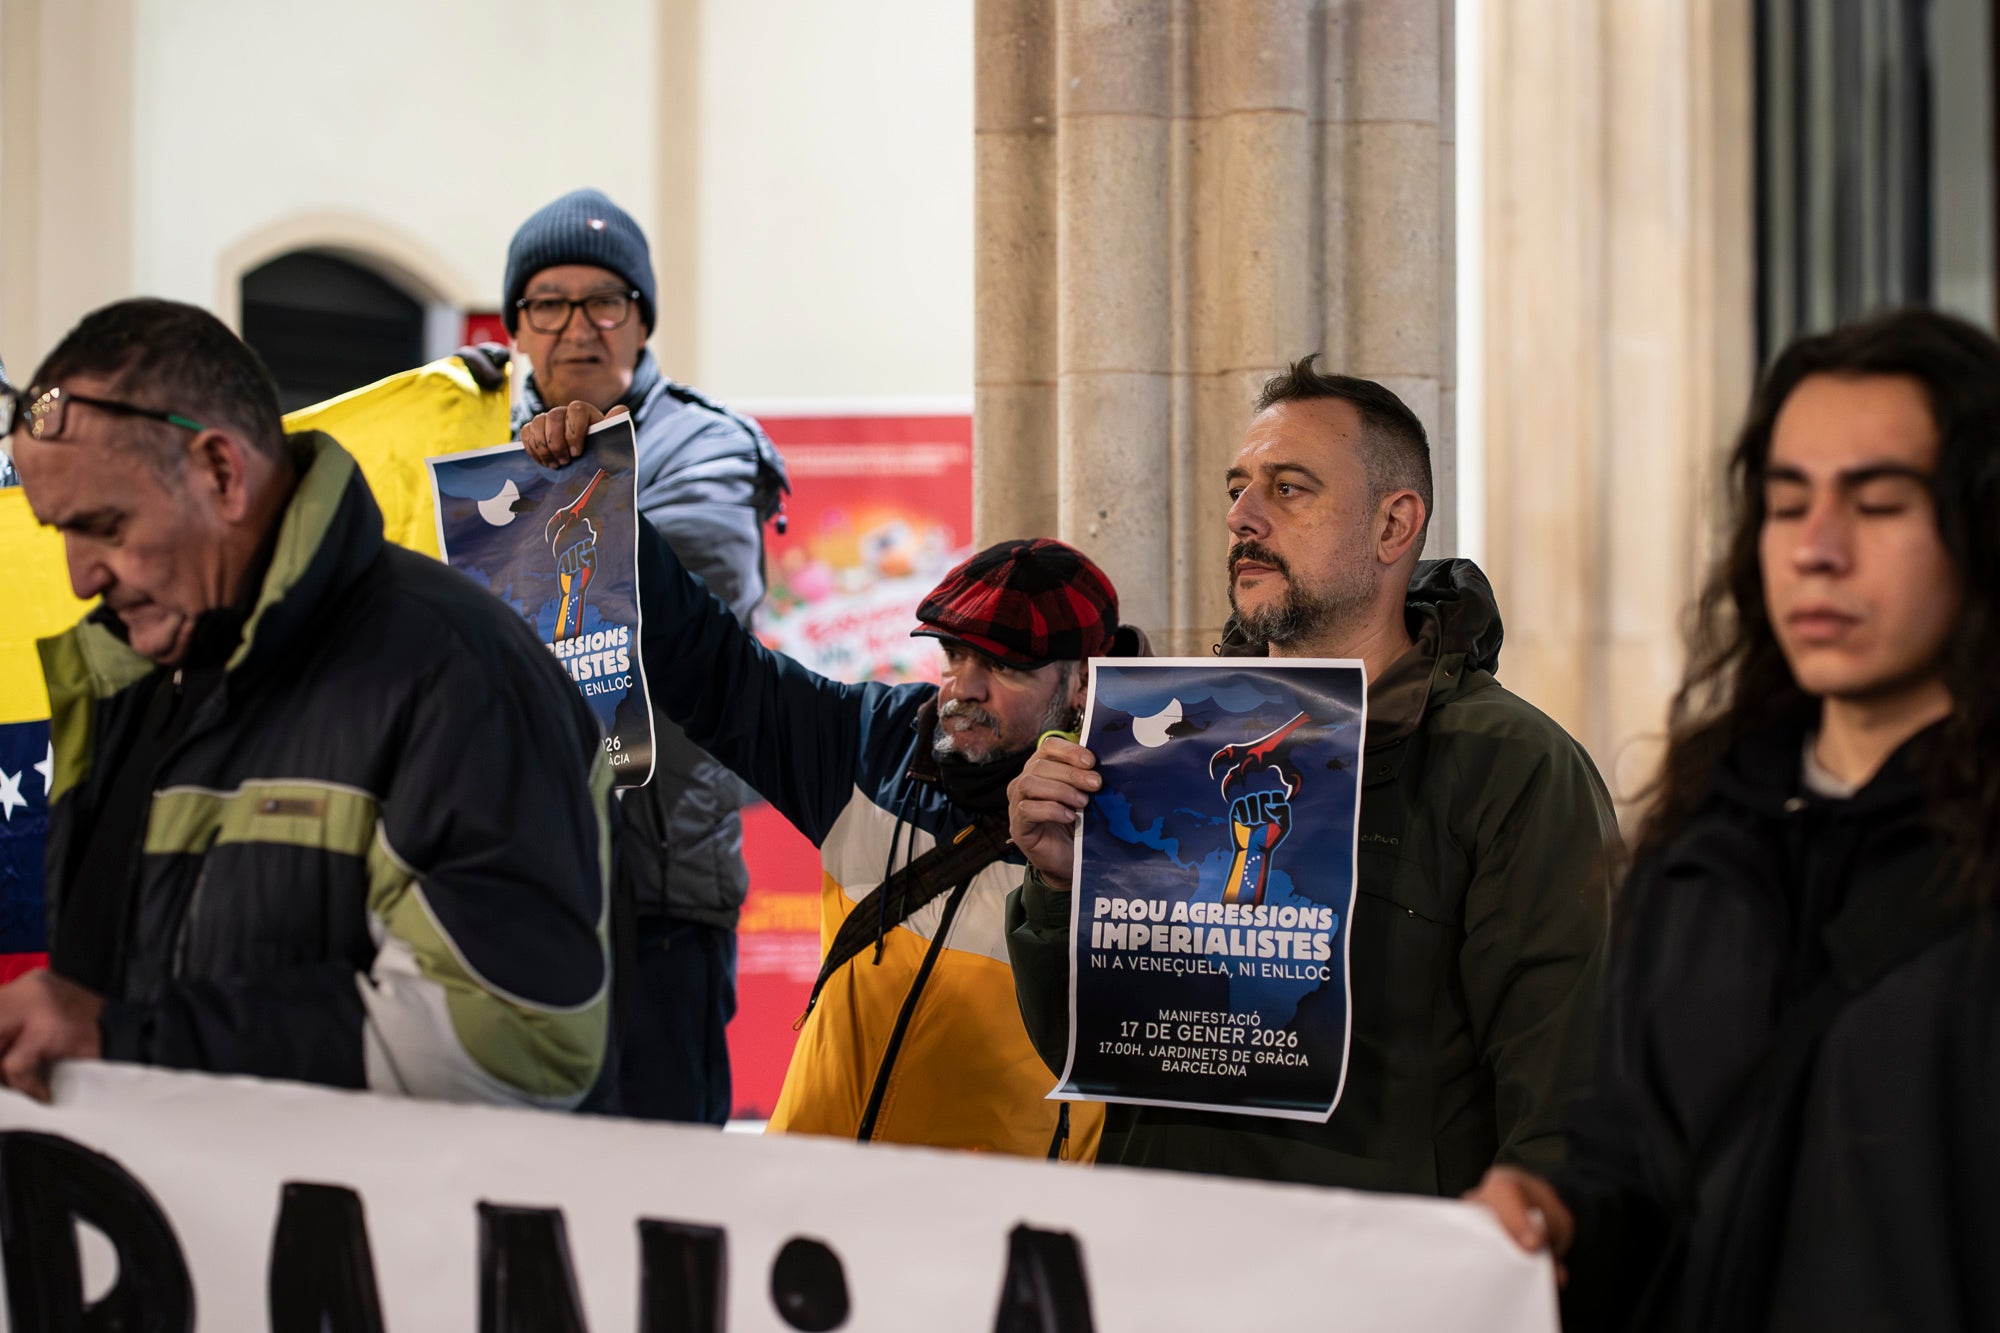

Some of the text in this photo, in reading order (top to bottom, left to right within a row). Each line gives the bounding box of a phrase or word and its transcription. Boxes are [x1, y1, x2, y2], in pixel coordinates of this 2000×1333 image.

[585, 675, 633, 697] ENLLOC
[602, 736, 621, 752] 26
[608, 753, 630, 766] ÀCIA
[1093, 897, 1333, 930] PROU AGRESSIONS
[1091, 922, 1331, 961] IMPERIALISTES
[1091, 954, 1331, 981] NI A VENEÇUELA, NI ENLLOC
[1158, 1009, 1261, 1027] MANIFESTACIÓ
[1120, 1021, 1298, 1048] 17 DE GENER 2026
[1099, 1041, 1309, 1067] 17.00H. JARDINETS DE GRÀCIA
[1161, 1060, 1247, 1077] BARCELONA
